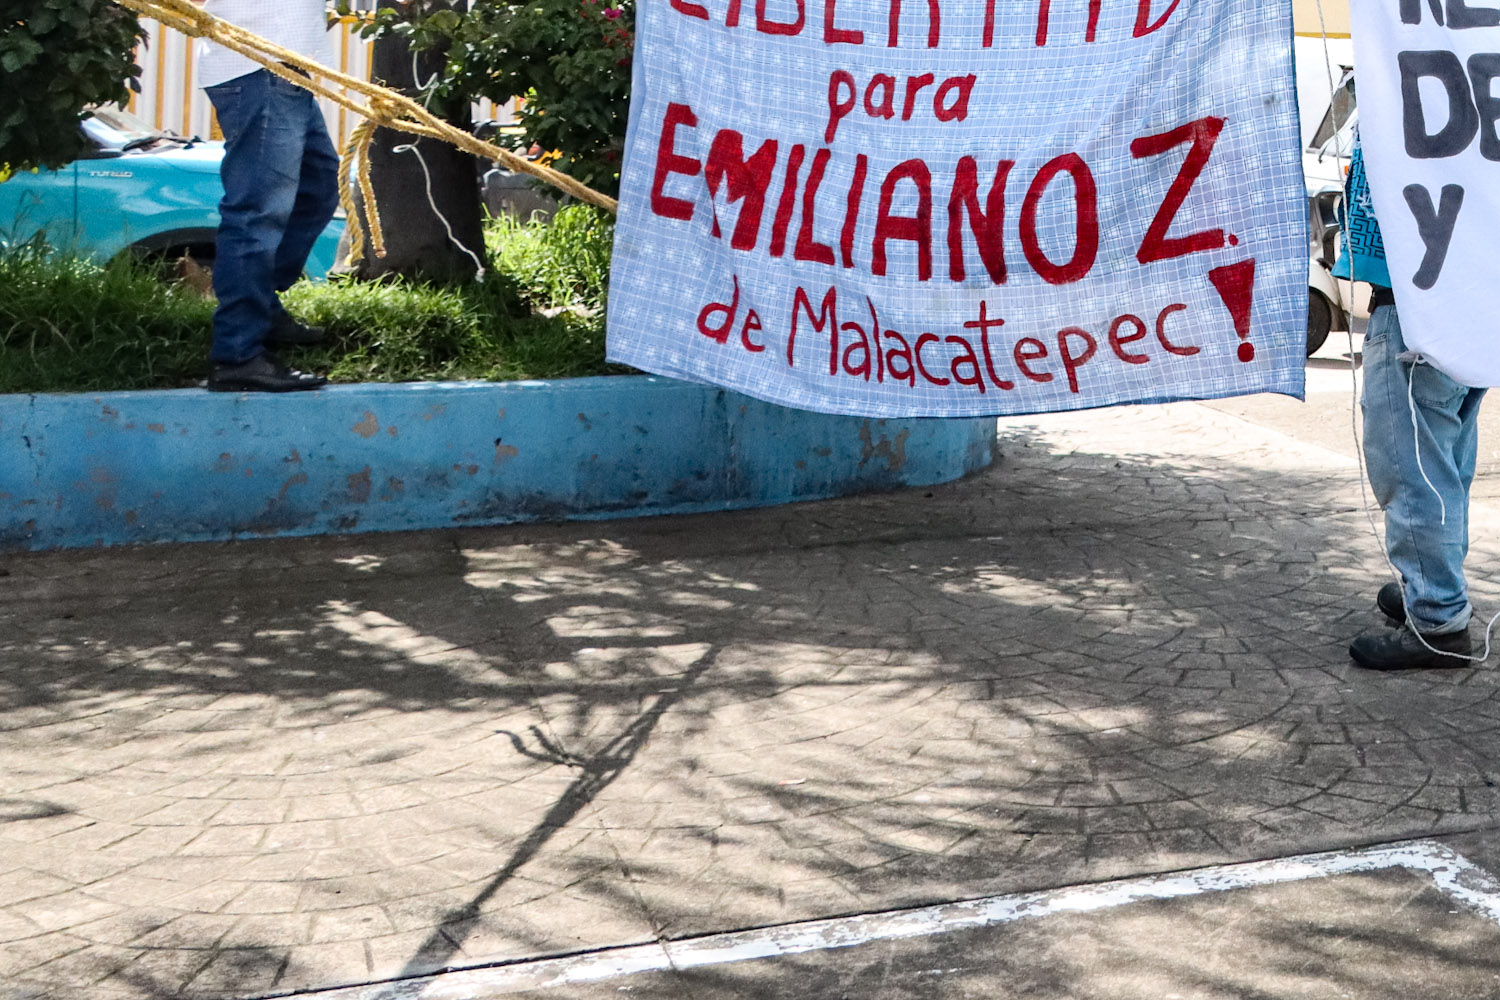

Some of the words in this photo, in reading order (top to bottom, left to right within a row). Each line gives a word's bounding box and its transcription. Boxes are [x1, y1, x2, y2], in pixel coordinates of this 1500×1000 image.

[826, 70, 977, 144] para
[650, 102, 1099, 285] EMILIANO
[697, 274, 766, 353] de
